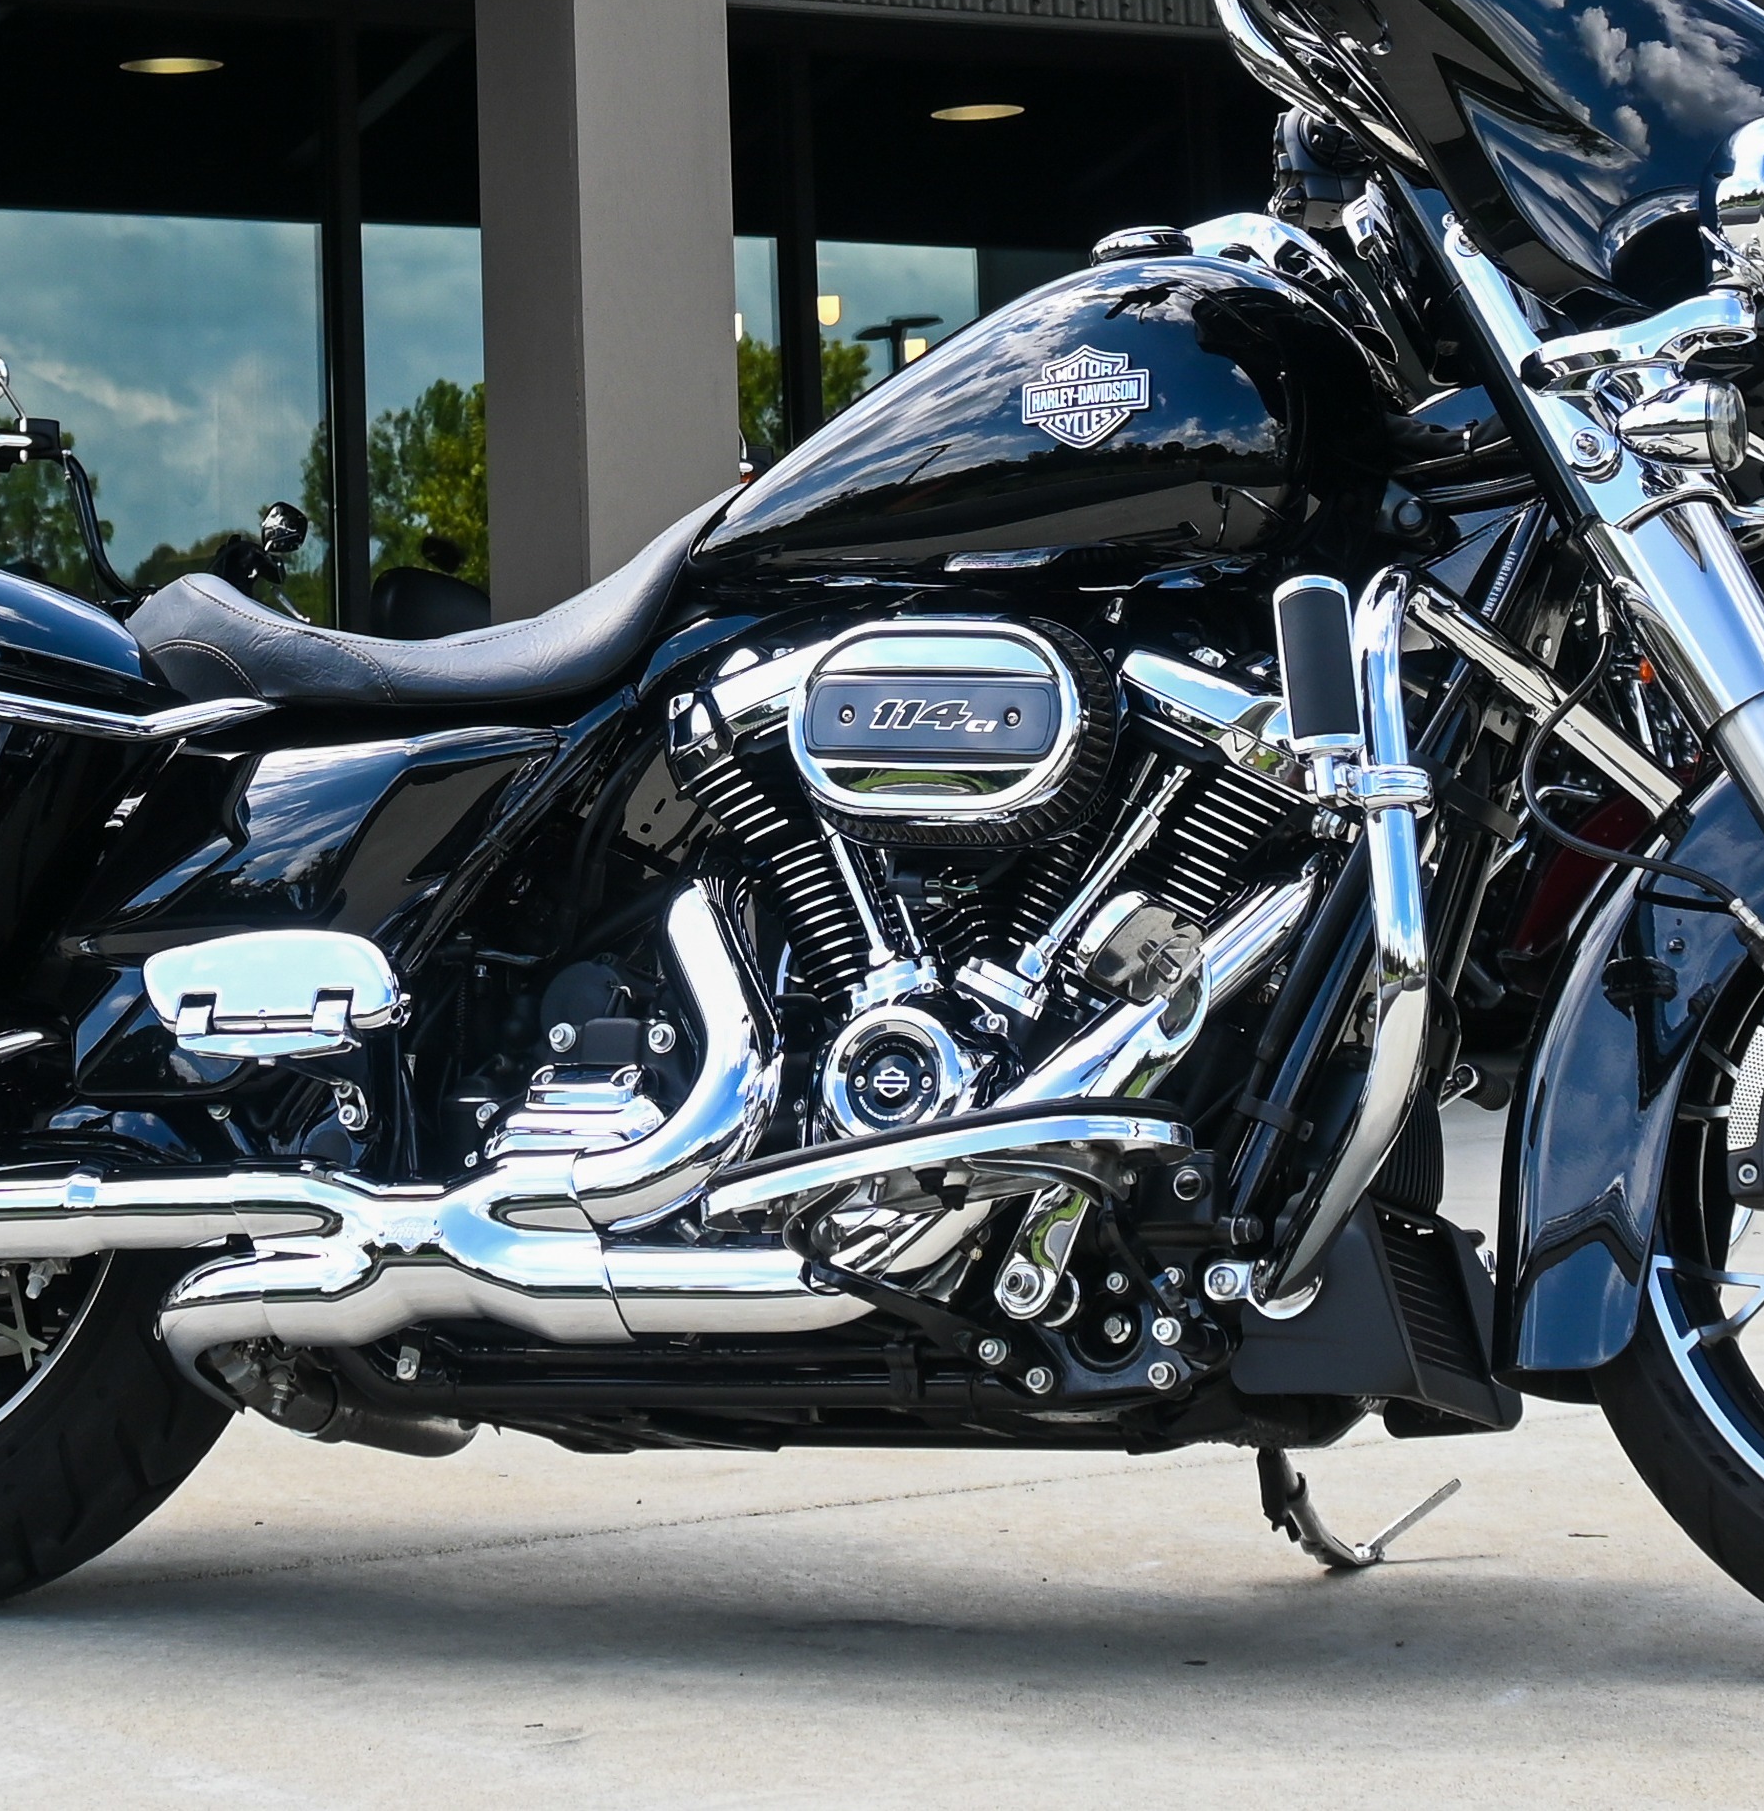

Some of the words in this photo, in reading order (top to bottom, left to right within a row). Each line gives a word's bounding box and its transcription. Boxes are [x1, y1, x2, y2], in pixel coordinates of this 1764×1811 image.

[1056, 360, 1113, 382] MOTOR
[1031, 379, 1139, 413] HARLEY-DAVIDSON
[1054, 409, 1112, 437] CYCLES
